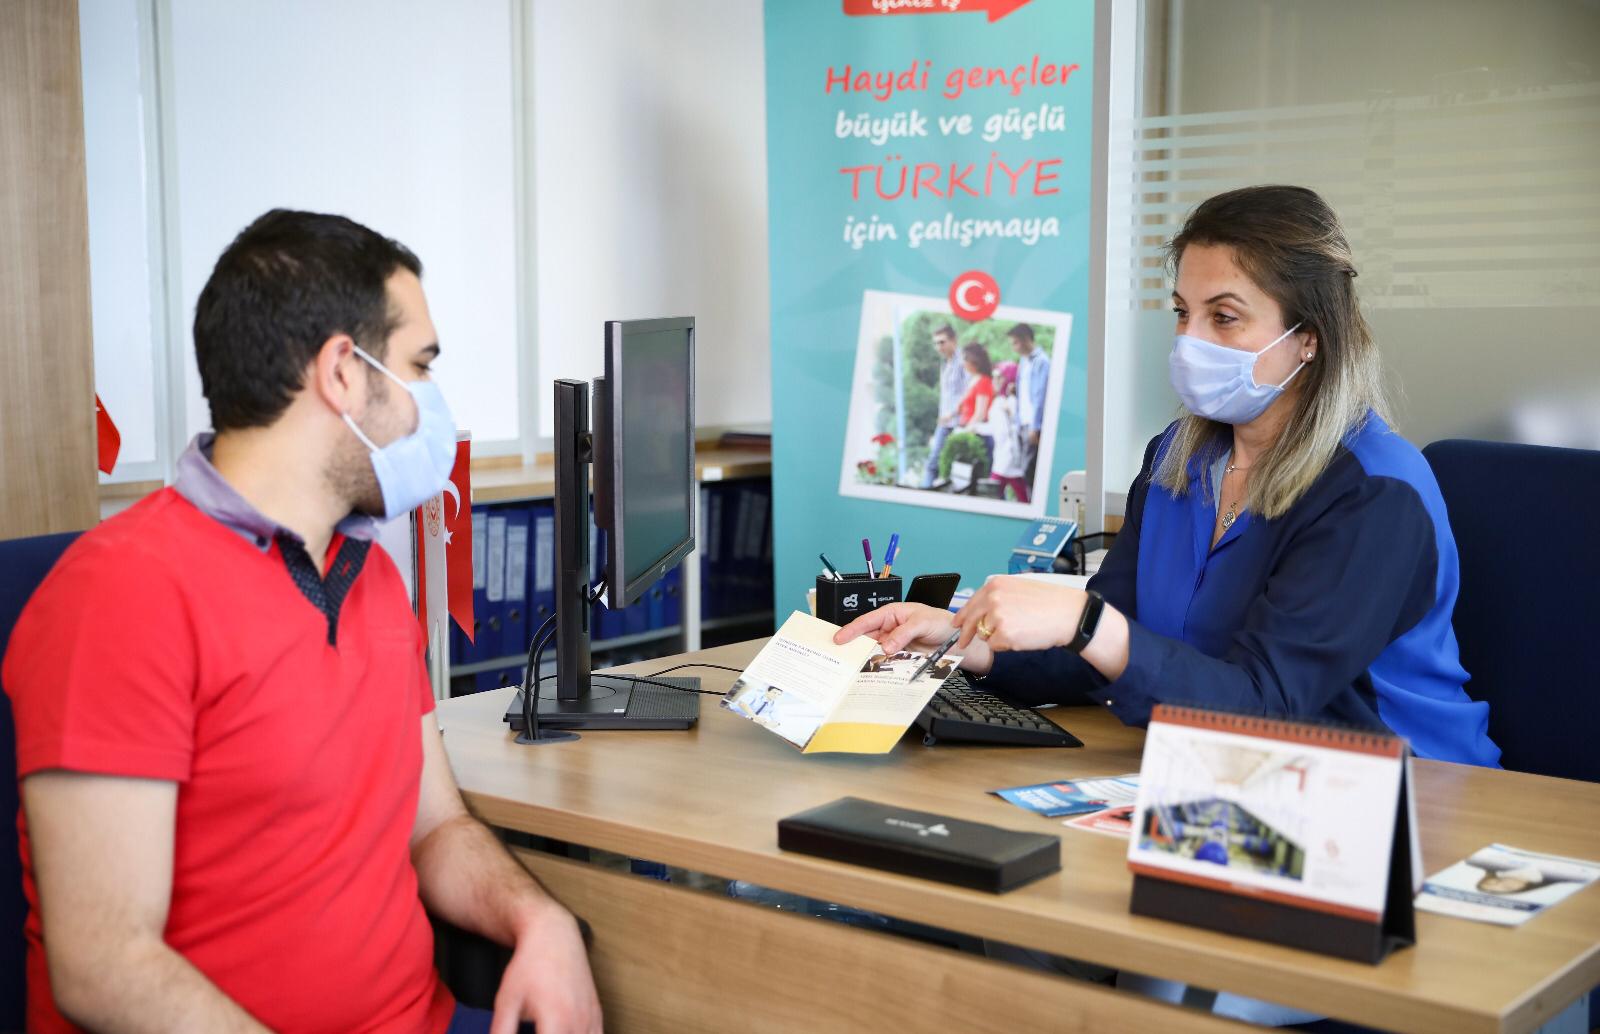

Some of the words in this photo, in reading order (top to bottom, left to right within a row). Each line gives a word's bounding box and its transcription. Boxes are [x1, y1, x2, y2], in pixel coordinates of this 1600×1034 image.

[826, 60, 932, 101] Haydi
[942, 54, 1080, 99] gençler
[835, 110, 928, 145] büyük
[939, 114, 973, 136] ve
[982, 104, 1066, 142] güçlü
[839, 151, 1063, 200] TÜRKİYE
[843, 215, 897, 250] için
[908, 212, 1060, 249] çalışmaya
